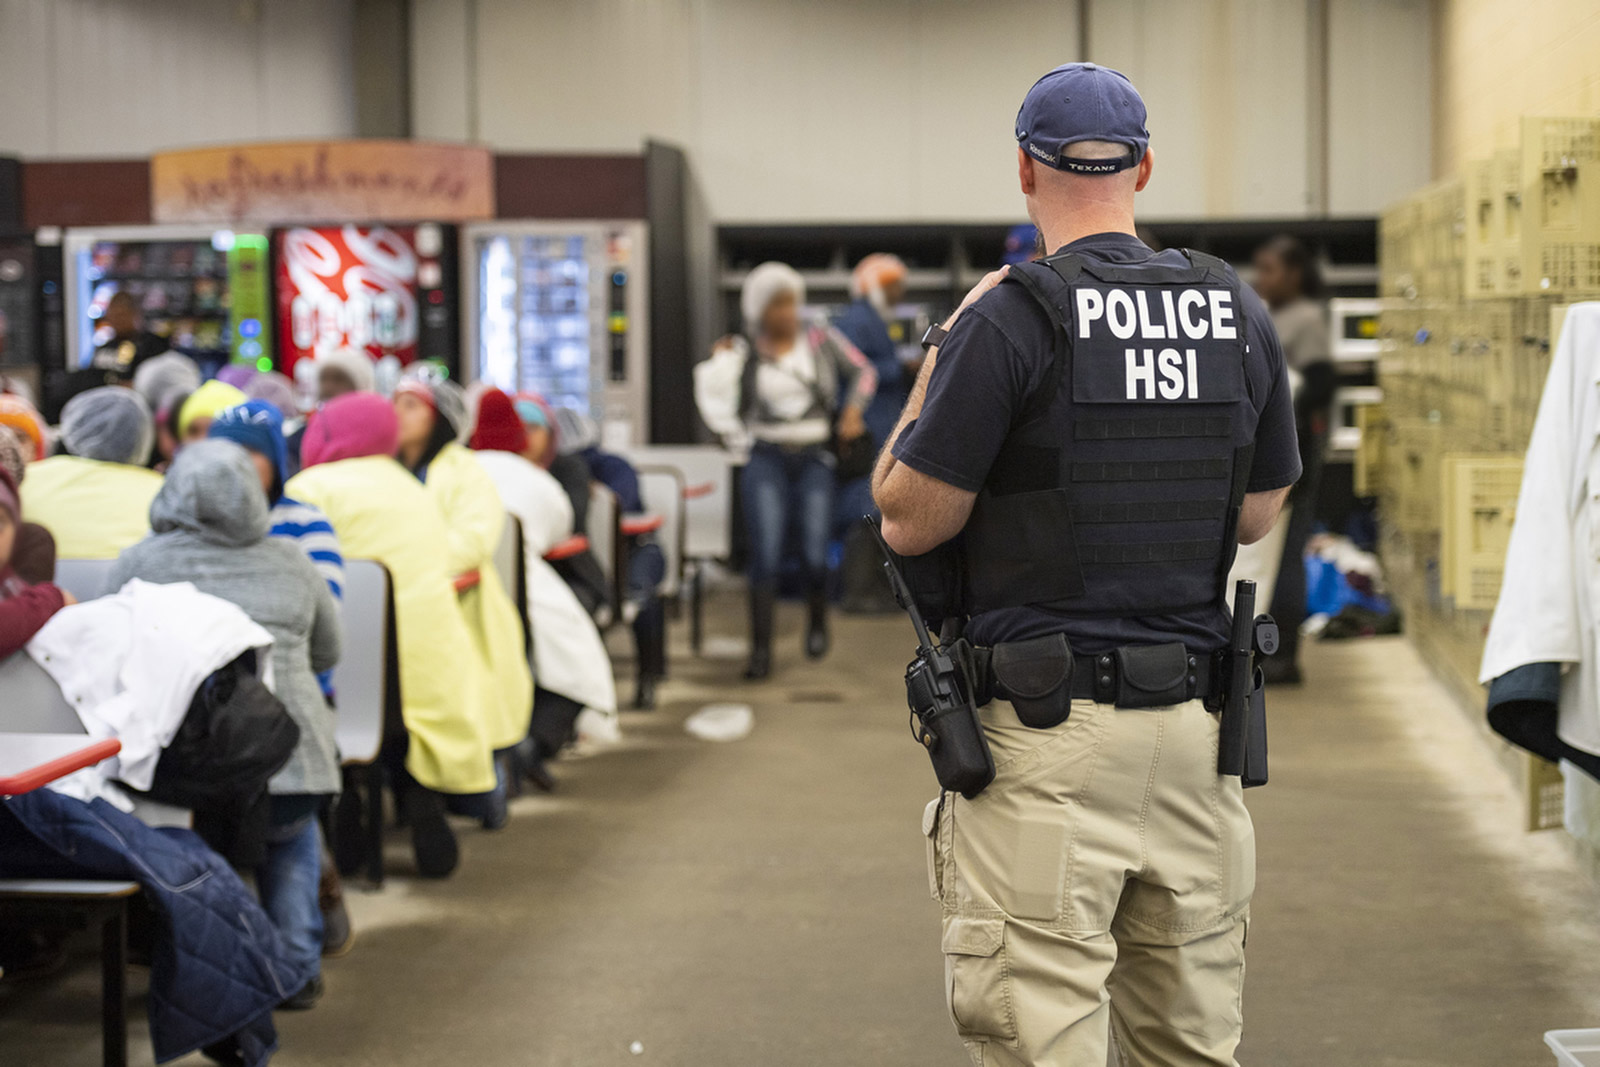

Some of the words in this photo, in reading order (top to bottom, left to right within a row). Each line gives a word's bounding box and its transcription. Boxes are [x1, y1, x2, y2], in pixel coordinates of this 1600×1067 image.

[1029, 142, 1056, 163] Reebok
[1069, 163, 1115, 172] TEXANS
[1076, 288, 1237, 339] POLICE
[1125, 348, 1198, 400] HSI
